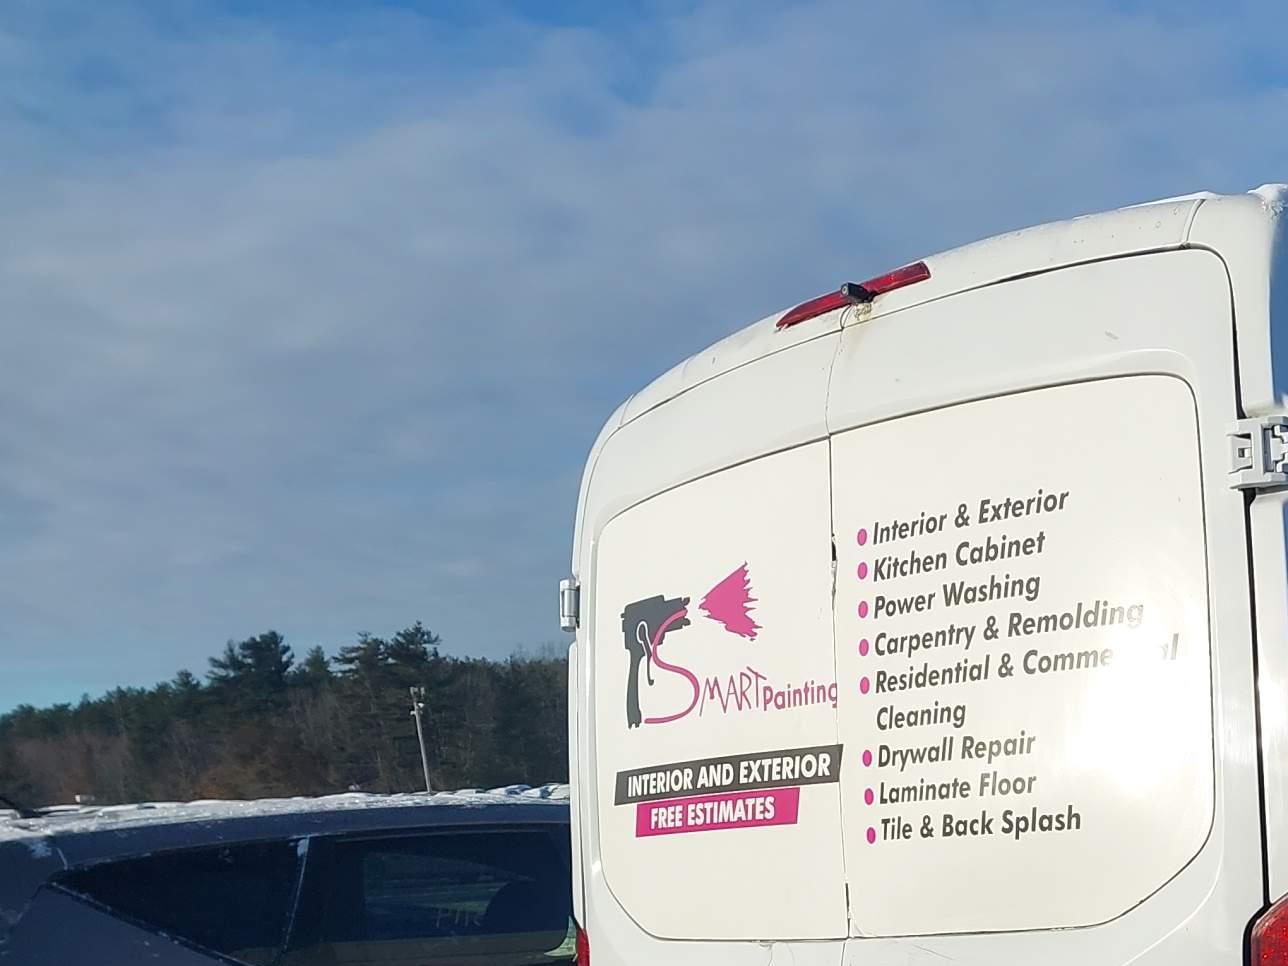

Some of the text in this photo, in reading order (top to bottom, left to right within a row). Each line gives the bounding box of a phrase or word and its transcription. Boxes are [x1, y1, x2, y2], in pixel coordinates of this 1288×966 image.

[873, 489, 1069, 545] Interior & Exterior
[873, 531, 1045, 582] Kitchen Cabinet
[874, 574, 1041, 619] Power Washing
[874, 600, 1144, 657] Carpentry & Remolding
[875, 654, 990, 694] Residential
[998, 652, 1014, 677] &
[876, 700, 966, 730] Cleaning
[877, 730, 1036, 772] Drywall Repair
[627, 752, 831, 798] INTERIOR AND EXTERIOR
[879, 771, 1037, 804] Laminate Floor
[650, 796, 775, 830] FREE ESTIMATES
[881, 805, 1082, 841] Tile & Back Splash
